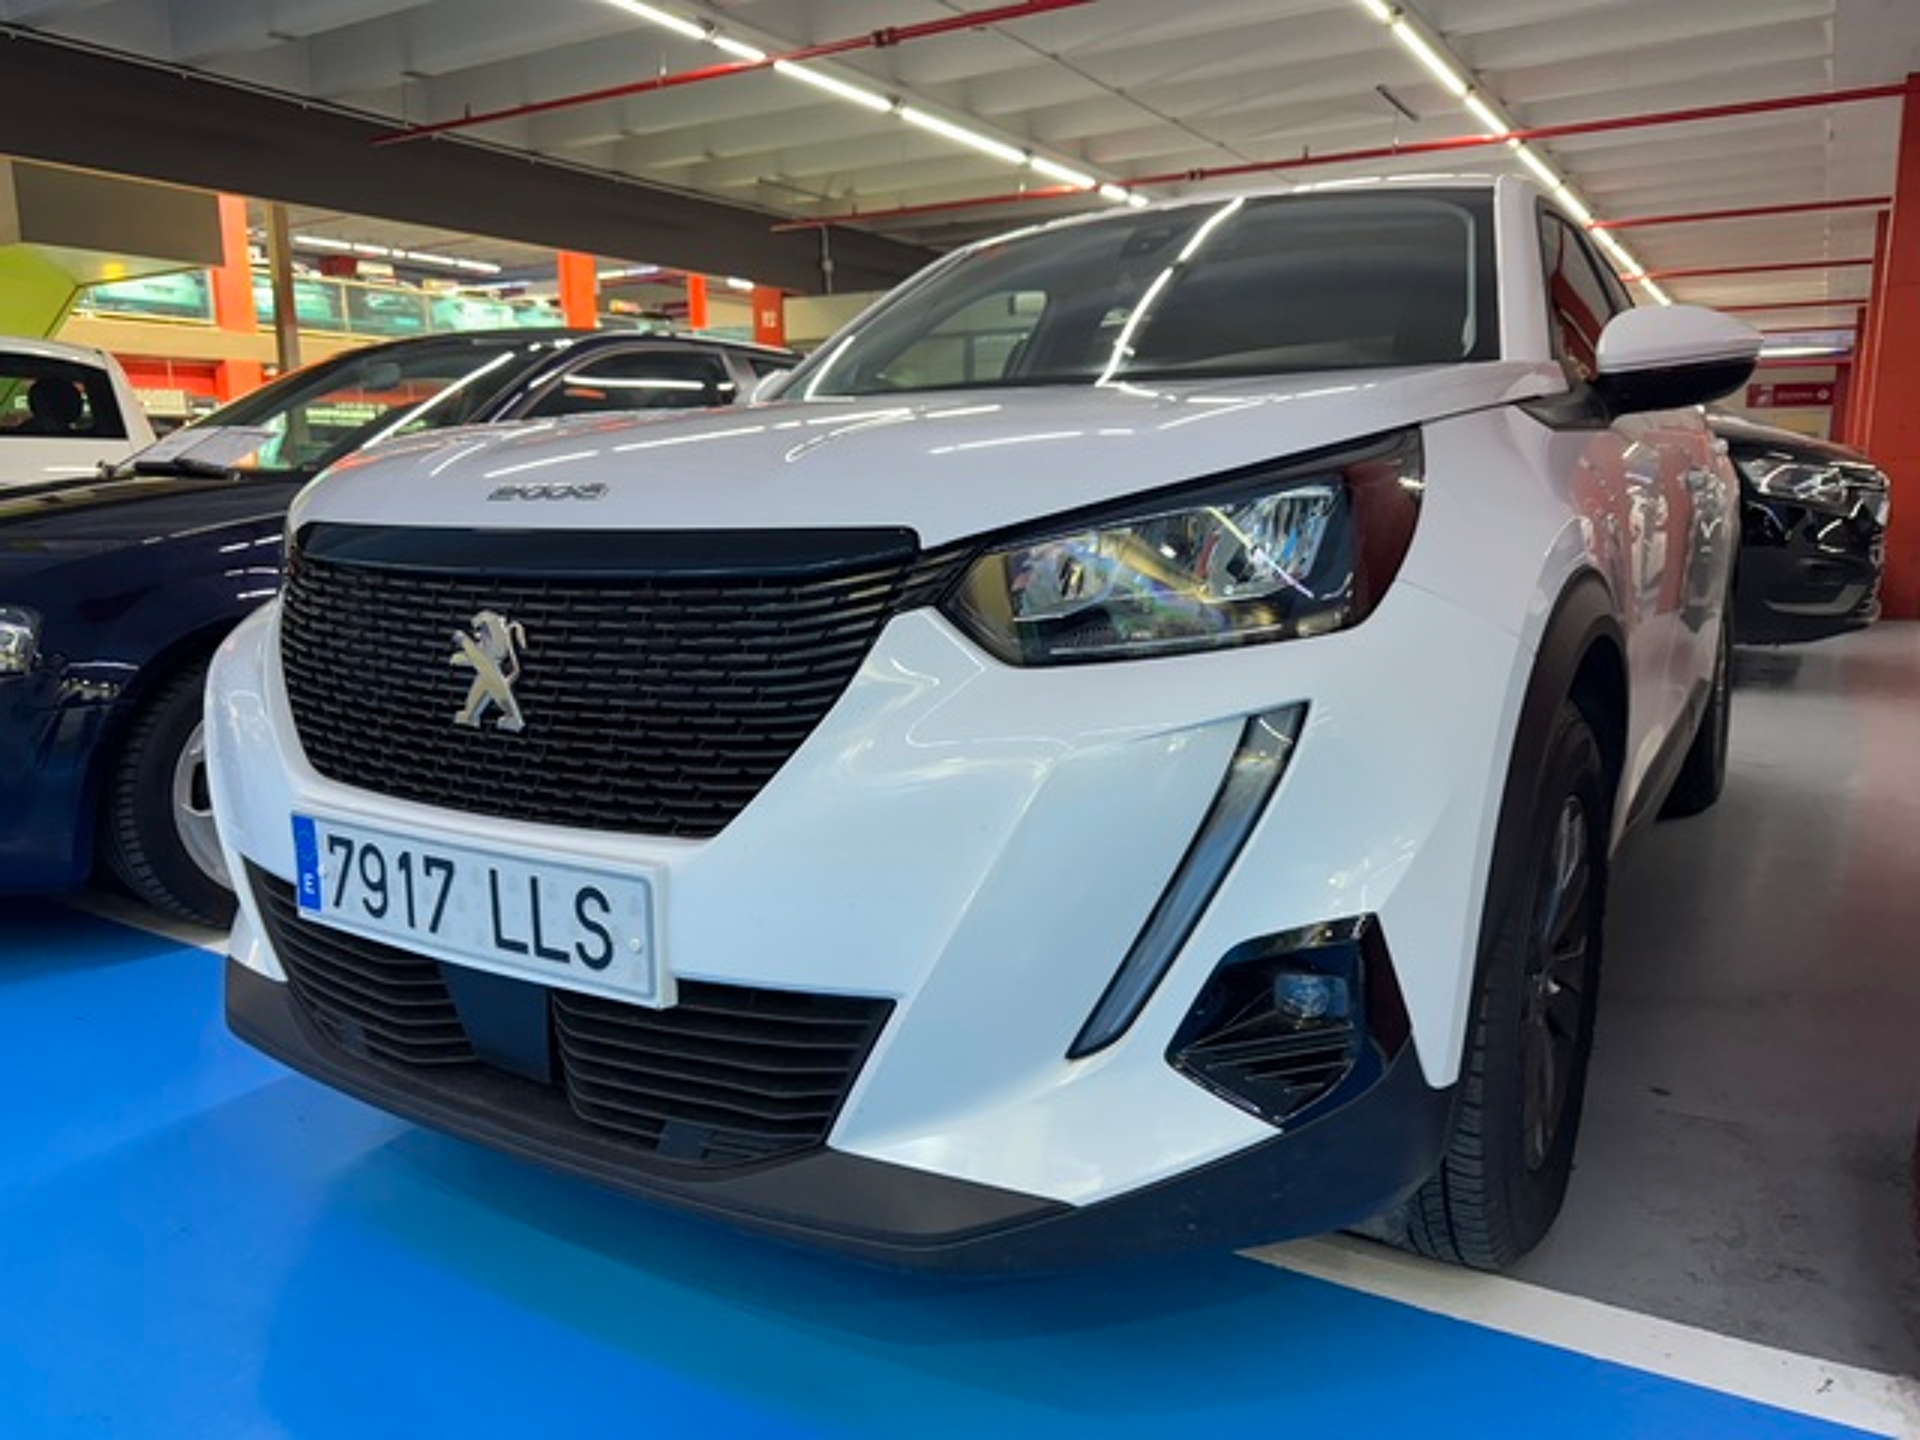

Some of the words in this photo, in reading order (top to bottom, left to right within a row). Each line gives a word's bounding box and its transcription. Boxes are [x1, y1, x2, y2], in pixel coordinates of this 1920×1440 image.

[304, 872, 315, 895] E
[326, 834, 455, 934] 7917
[488, 868, 614, 971] LLS
